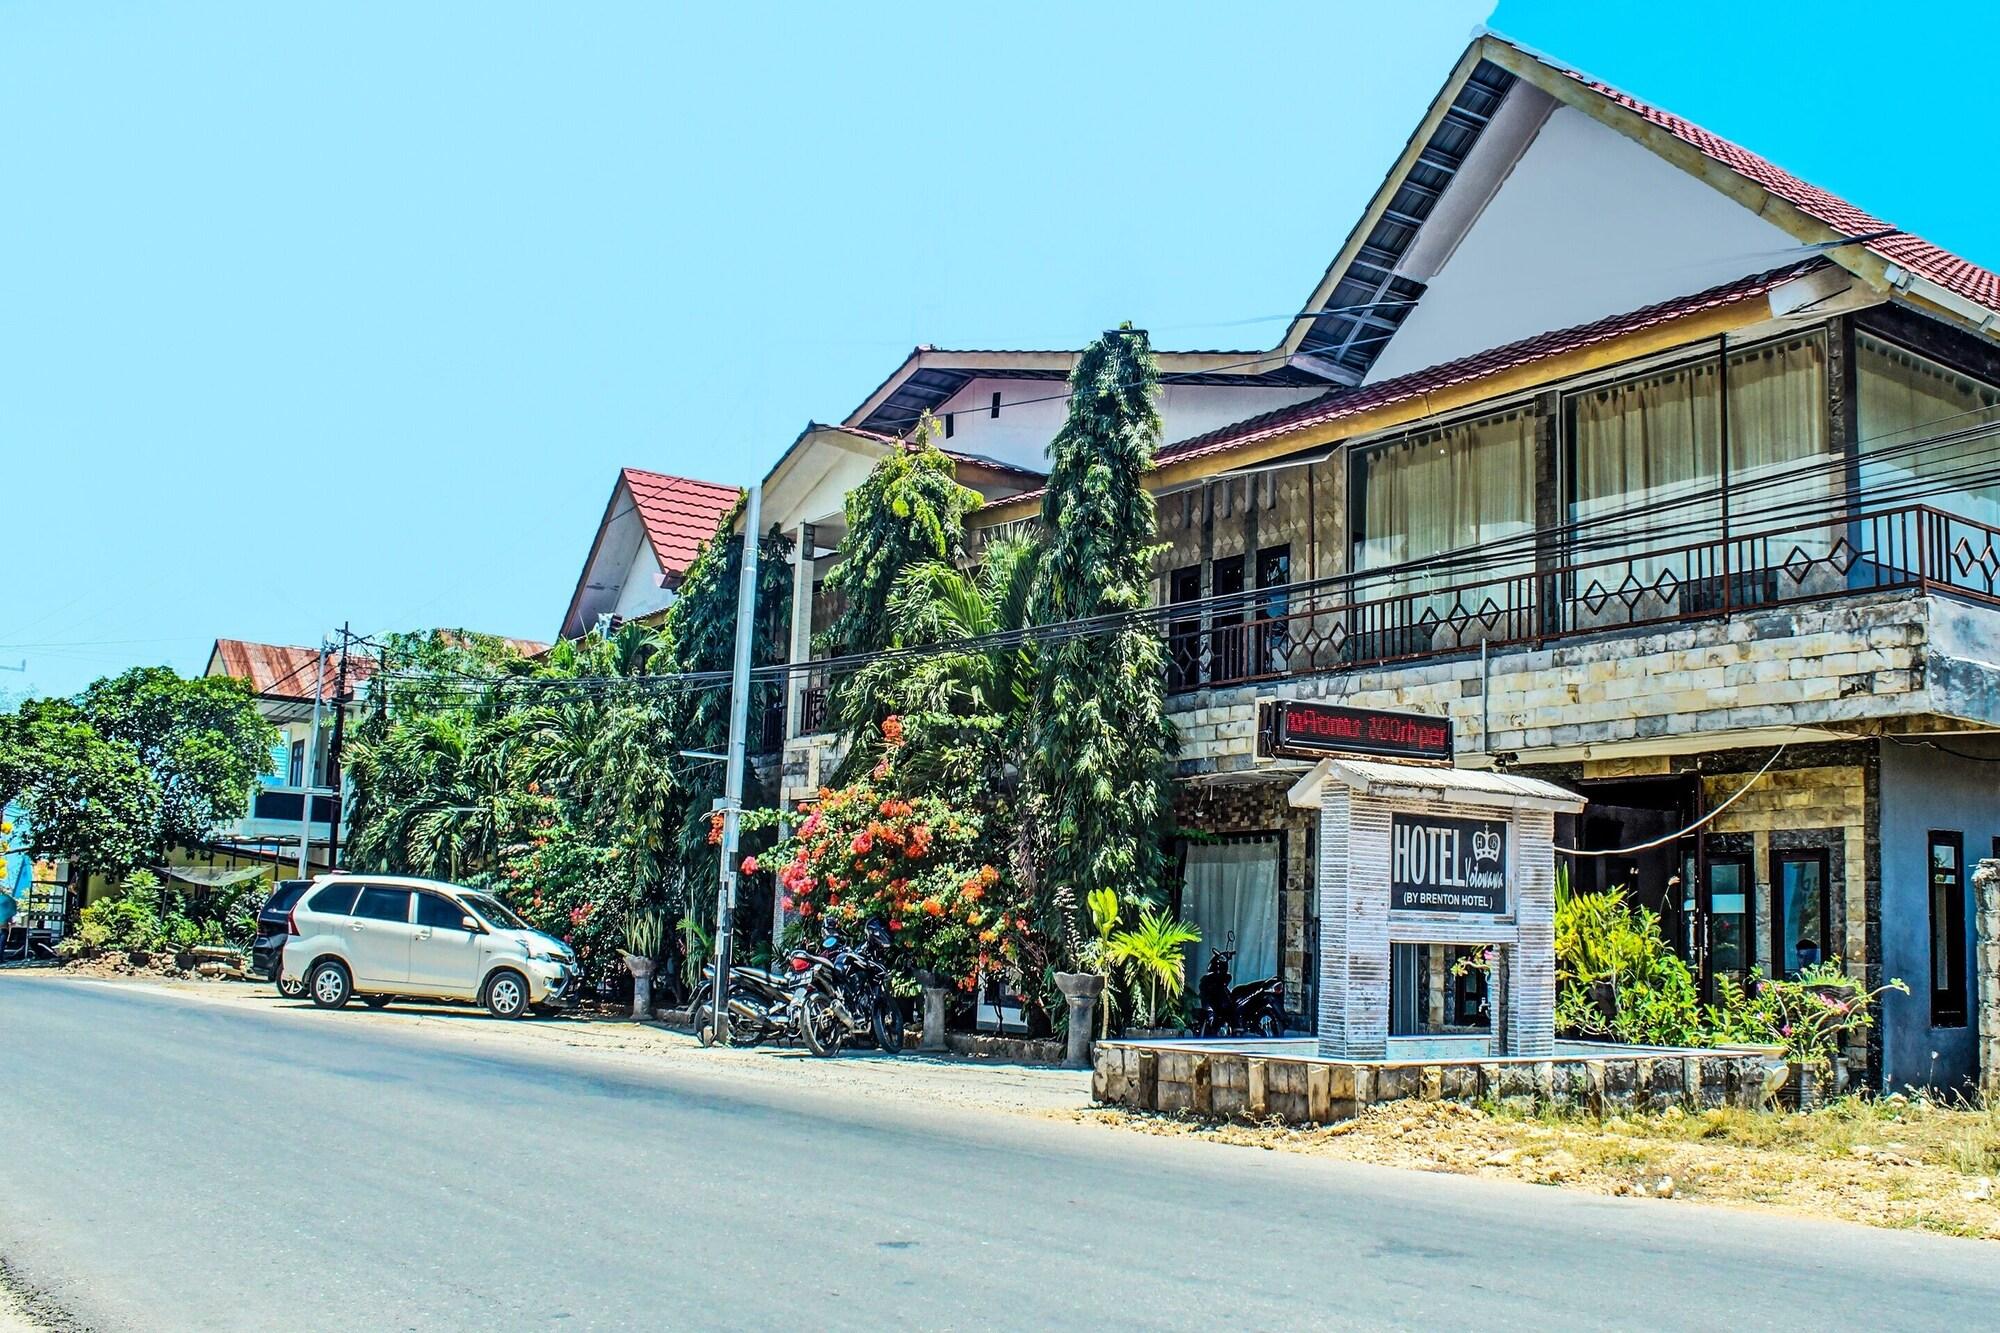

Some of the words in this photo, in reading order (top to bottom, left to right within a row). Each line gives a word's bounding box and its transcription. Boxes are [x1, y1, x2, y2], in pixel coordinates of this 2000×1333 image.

[1394, 824, 1465, 887] HOTEL
[1404, 892, 1418, 905] (BY
[1420, 893, 1460, 906] BRENTON
